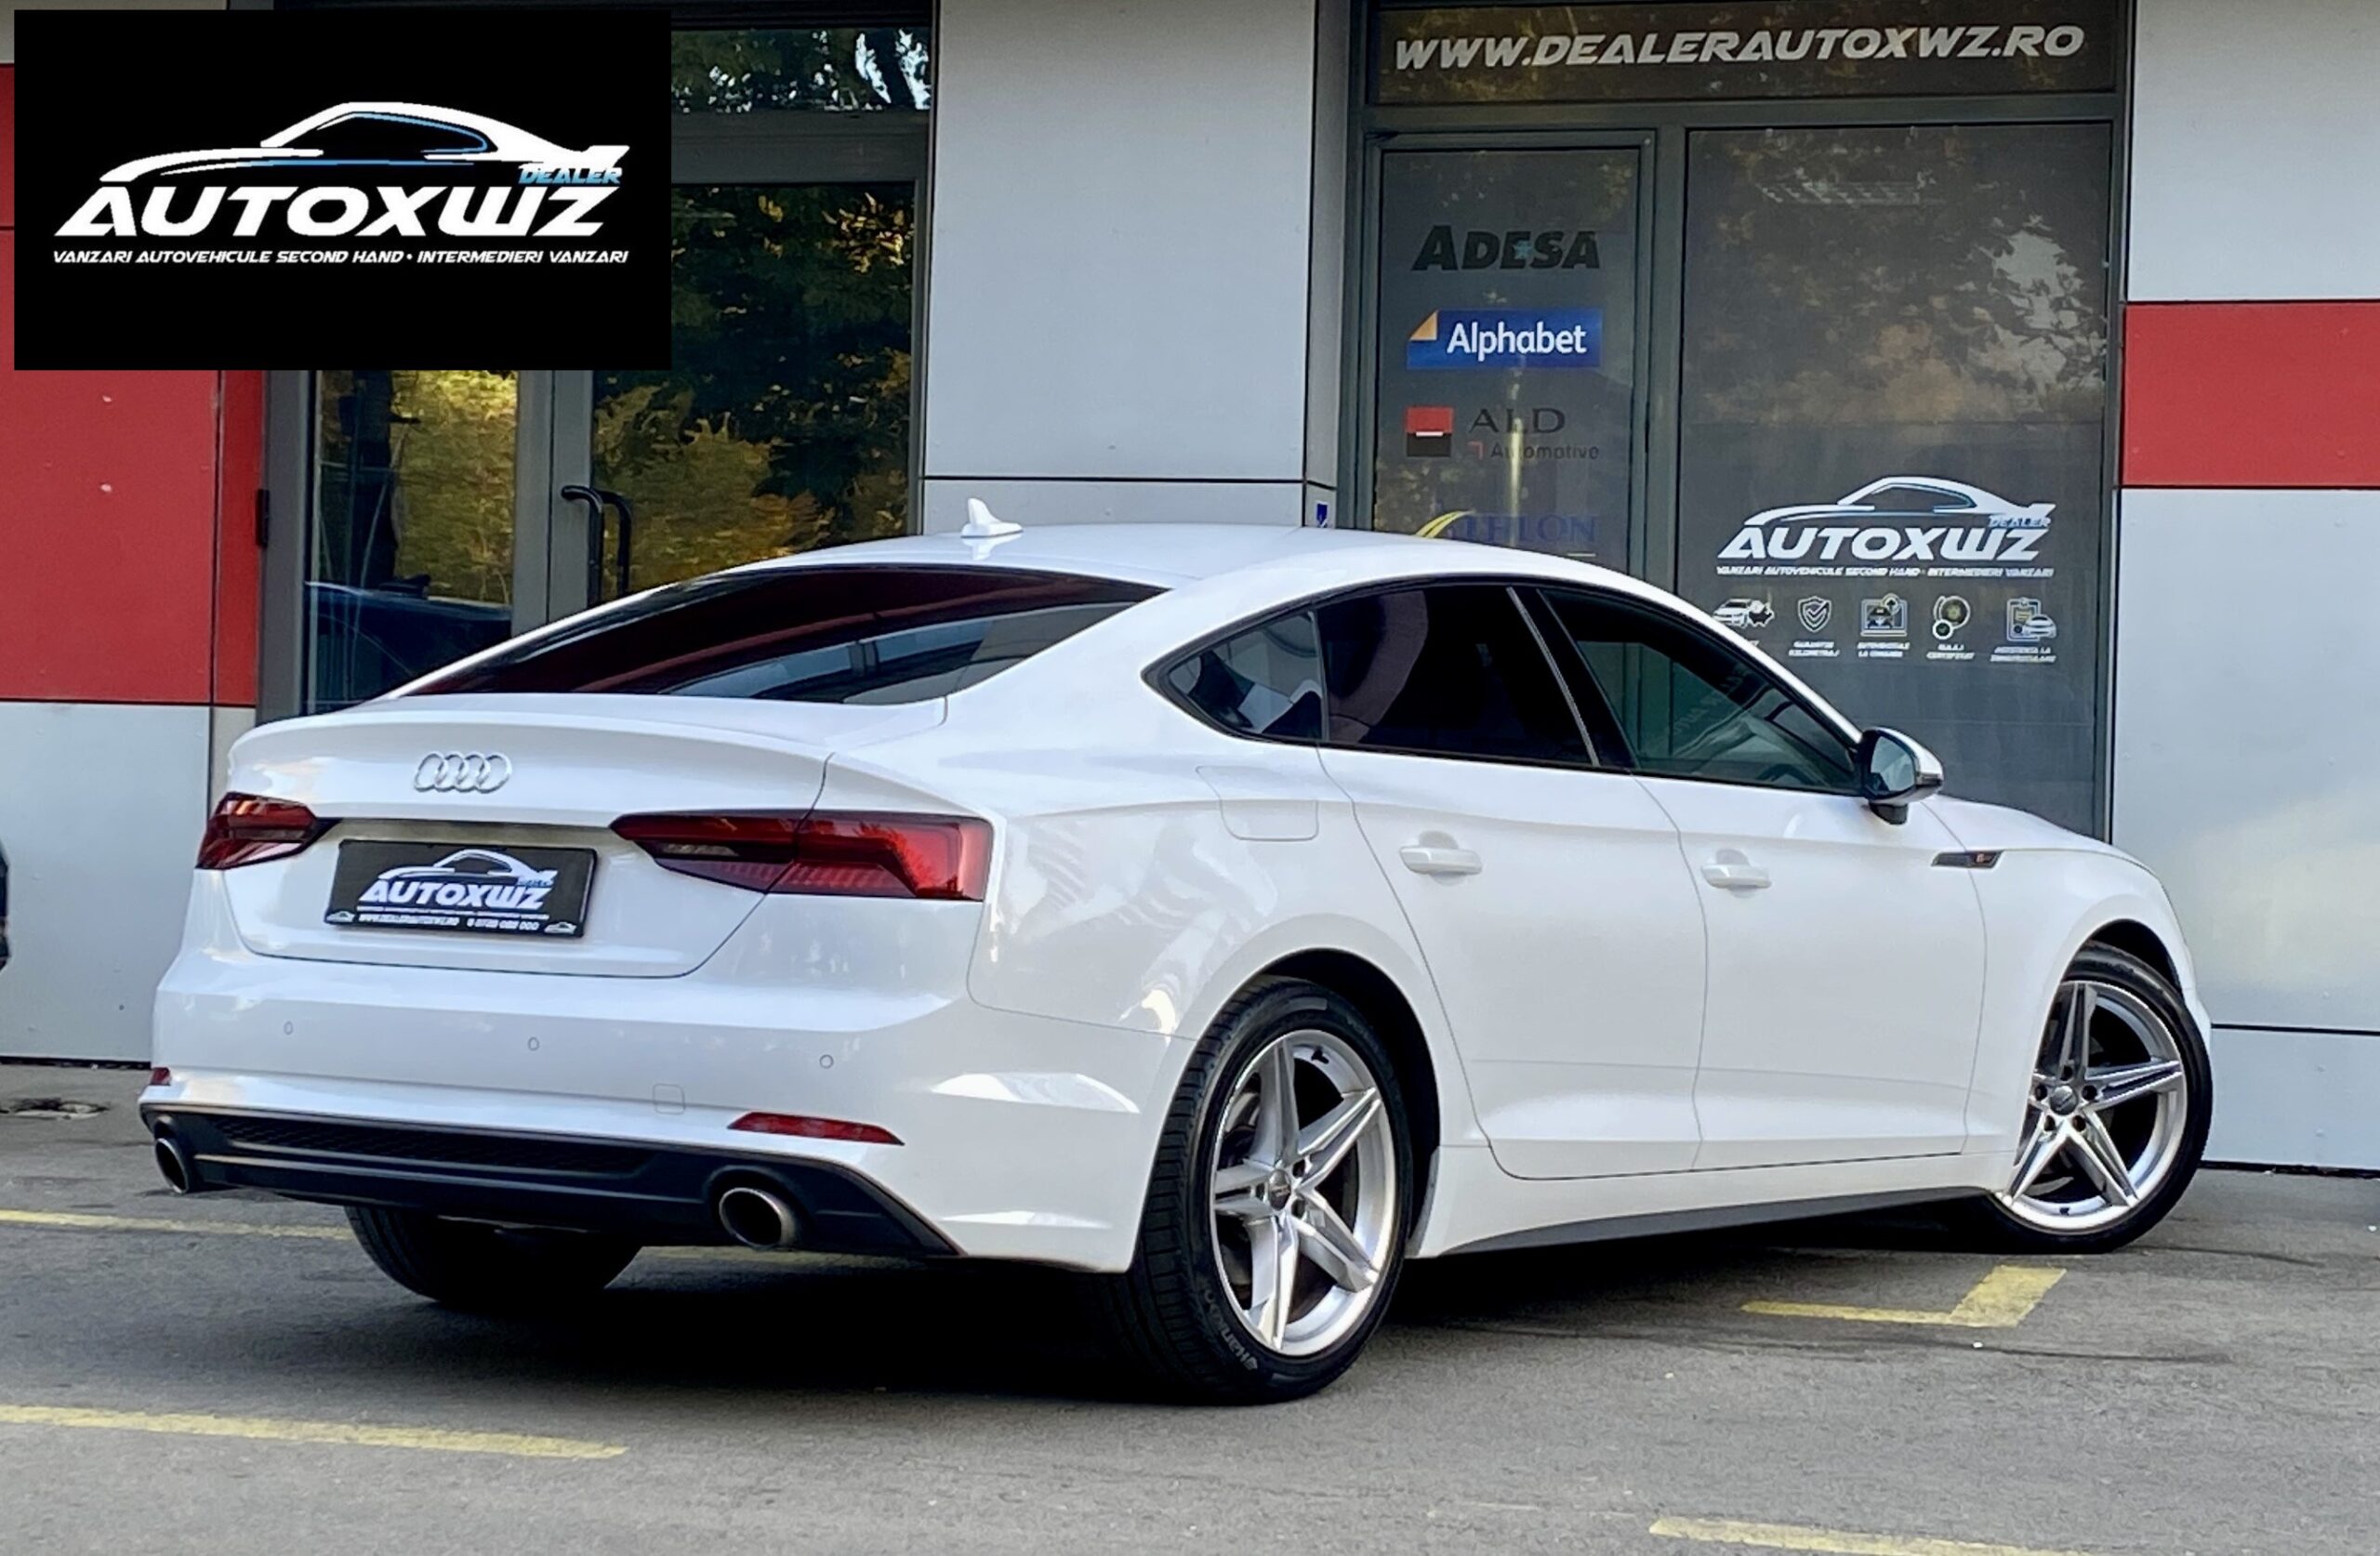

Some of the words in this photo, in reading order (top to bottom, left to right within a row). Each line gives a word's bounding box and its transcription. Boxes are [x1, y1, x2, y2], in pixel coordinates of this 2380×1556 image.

[1395, 25, 2085, 71] WWW.DEALERAUTOXWZ.RO
[1409, 225, 1600, 270] ADESA
[1446, 321, 1588, 363] Alphabet
[1468, 407, 1566, 434] ALD
[1716, 526, 2050, 561] AUTOXWZ
[359, 879, 553, 911] AUTOXWZ
